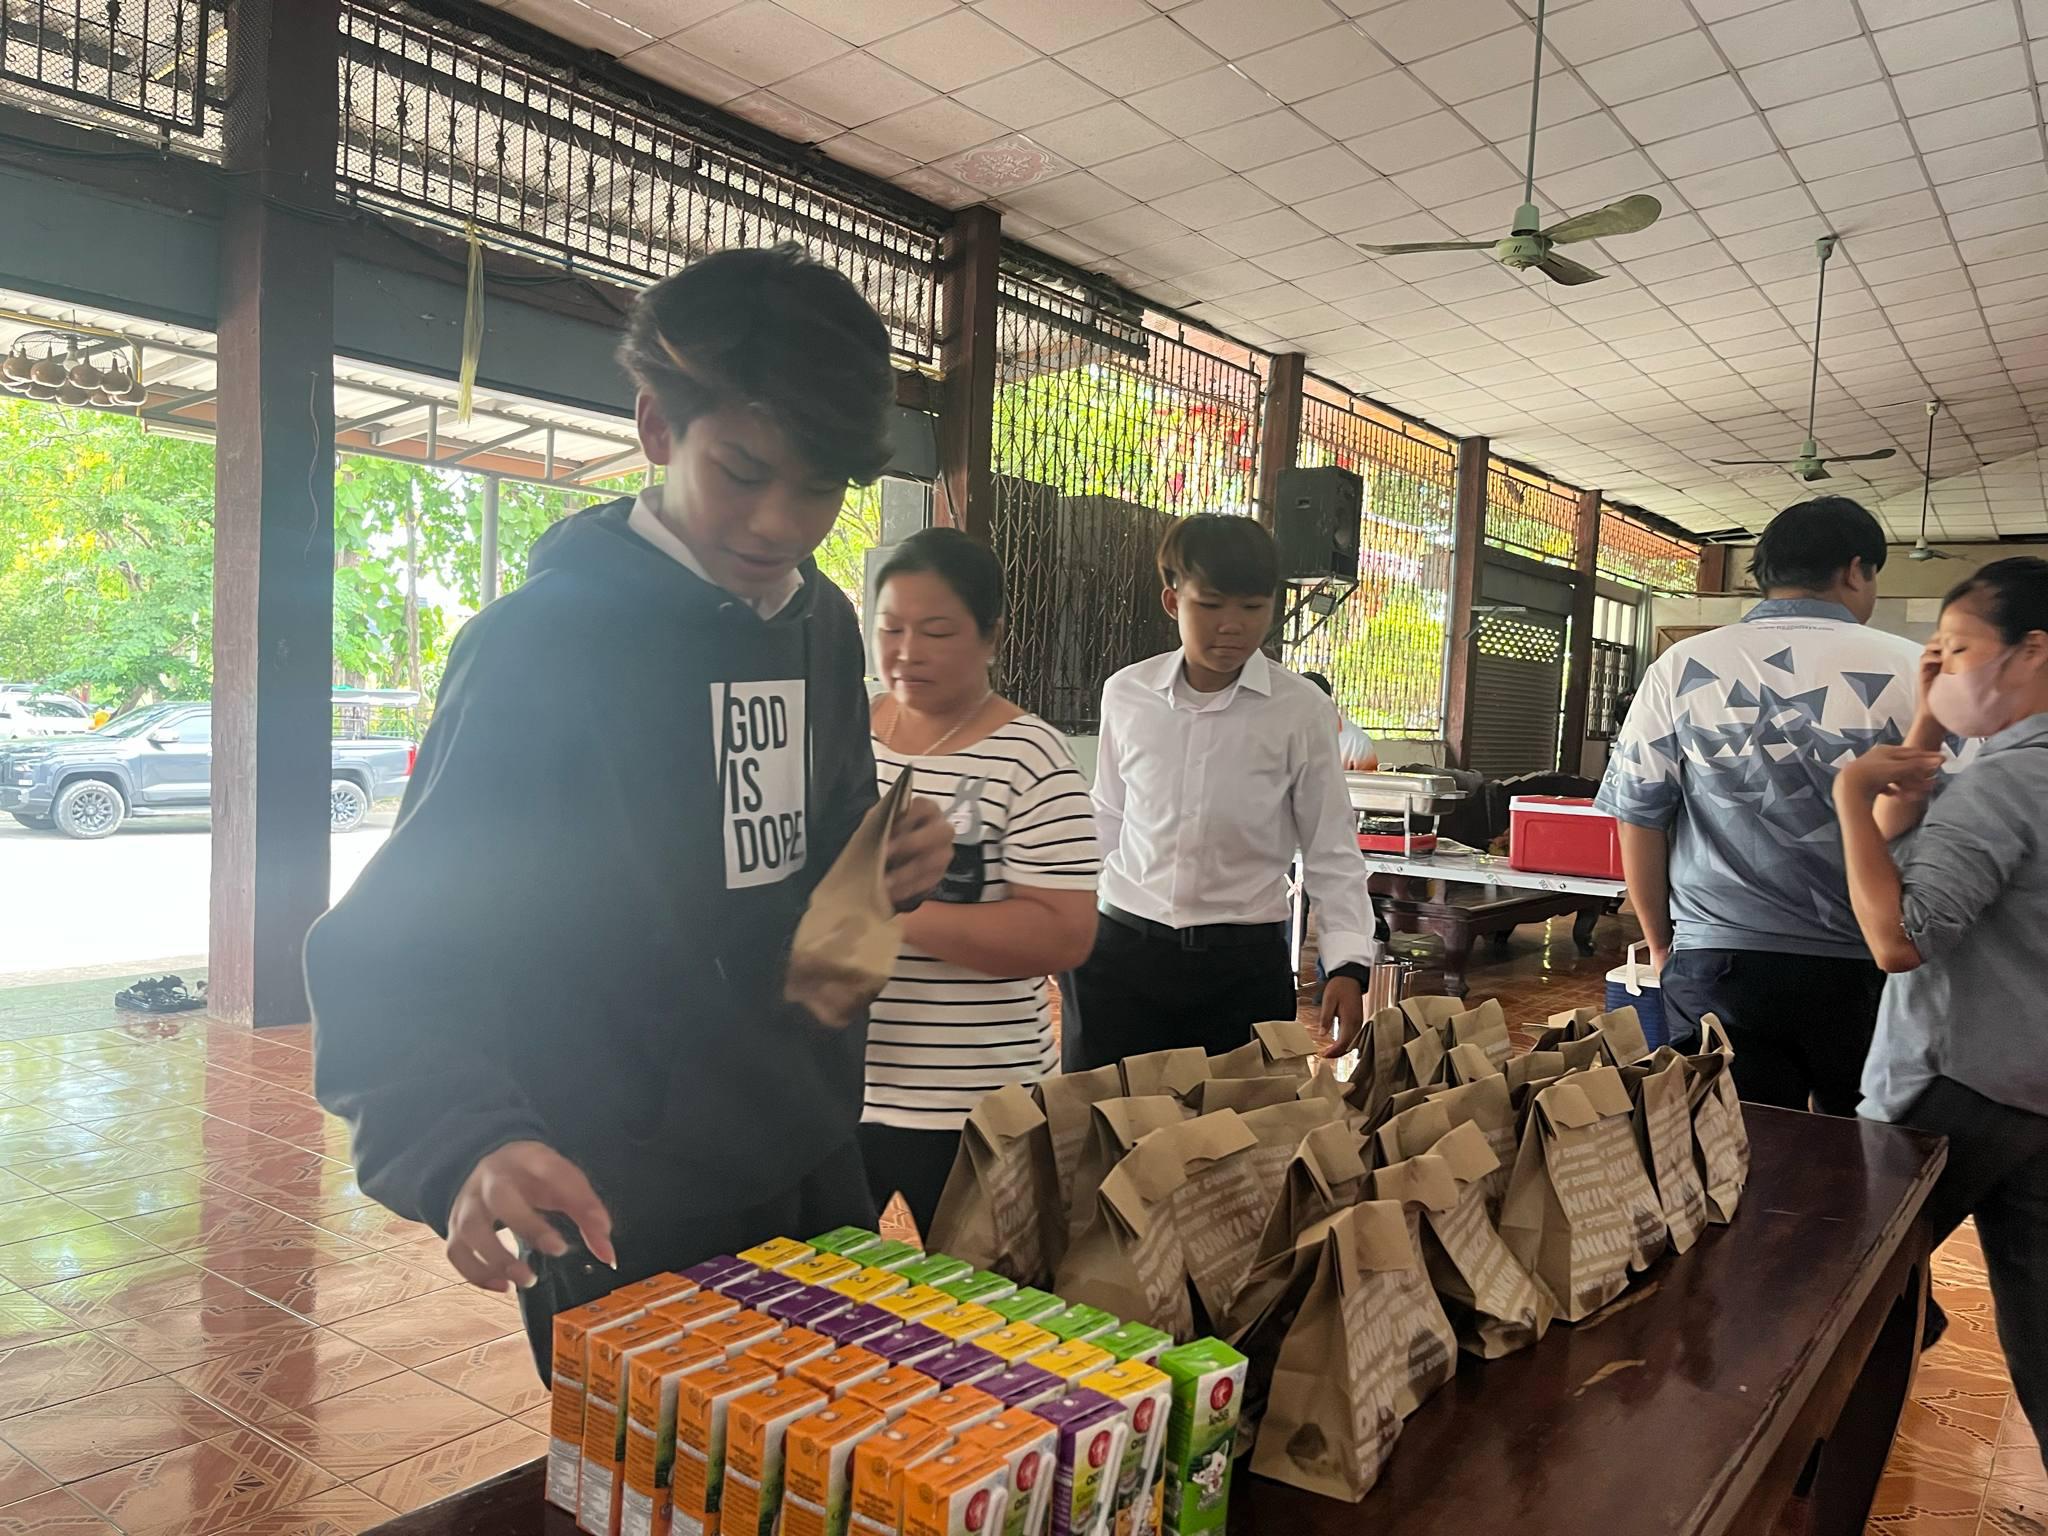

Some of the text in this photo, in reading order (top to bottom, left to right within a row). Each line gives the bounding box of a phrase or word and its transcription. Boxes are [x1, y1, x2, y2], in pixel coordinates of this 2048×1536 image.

[728, 695, 788, 754] GOD
[729, 756, 763, 815] IS
[733, 810, 804, 873] DOPE
